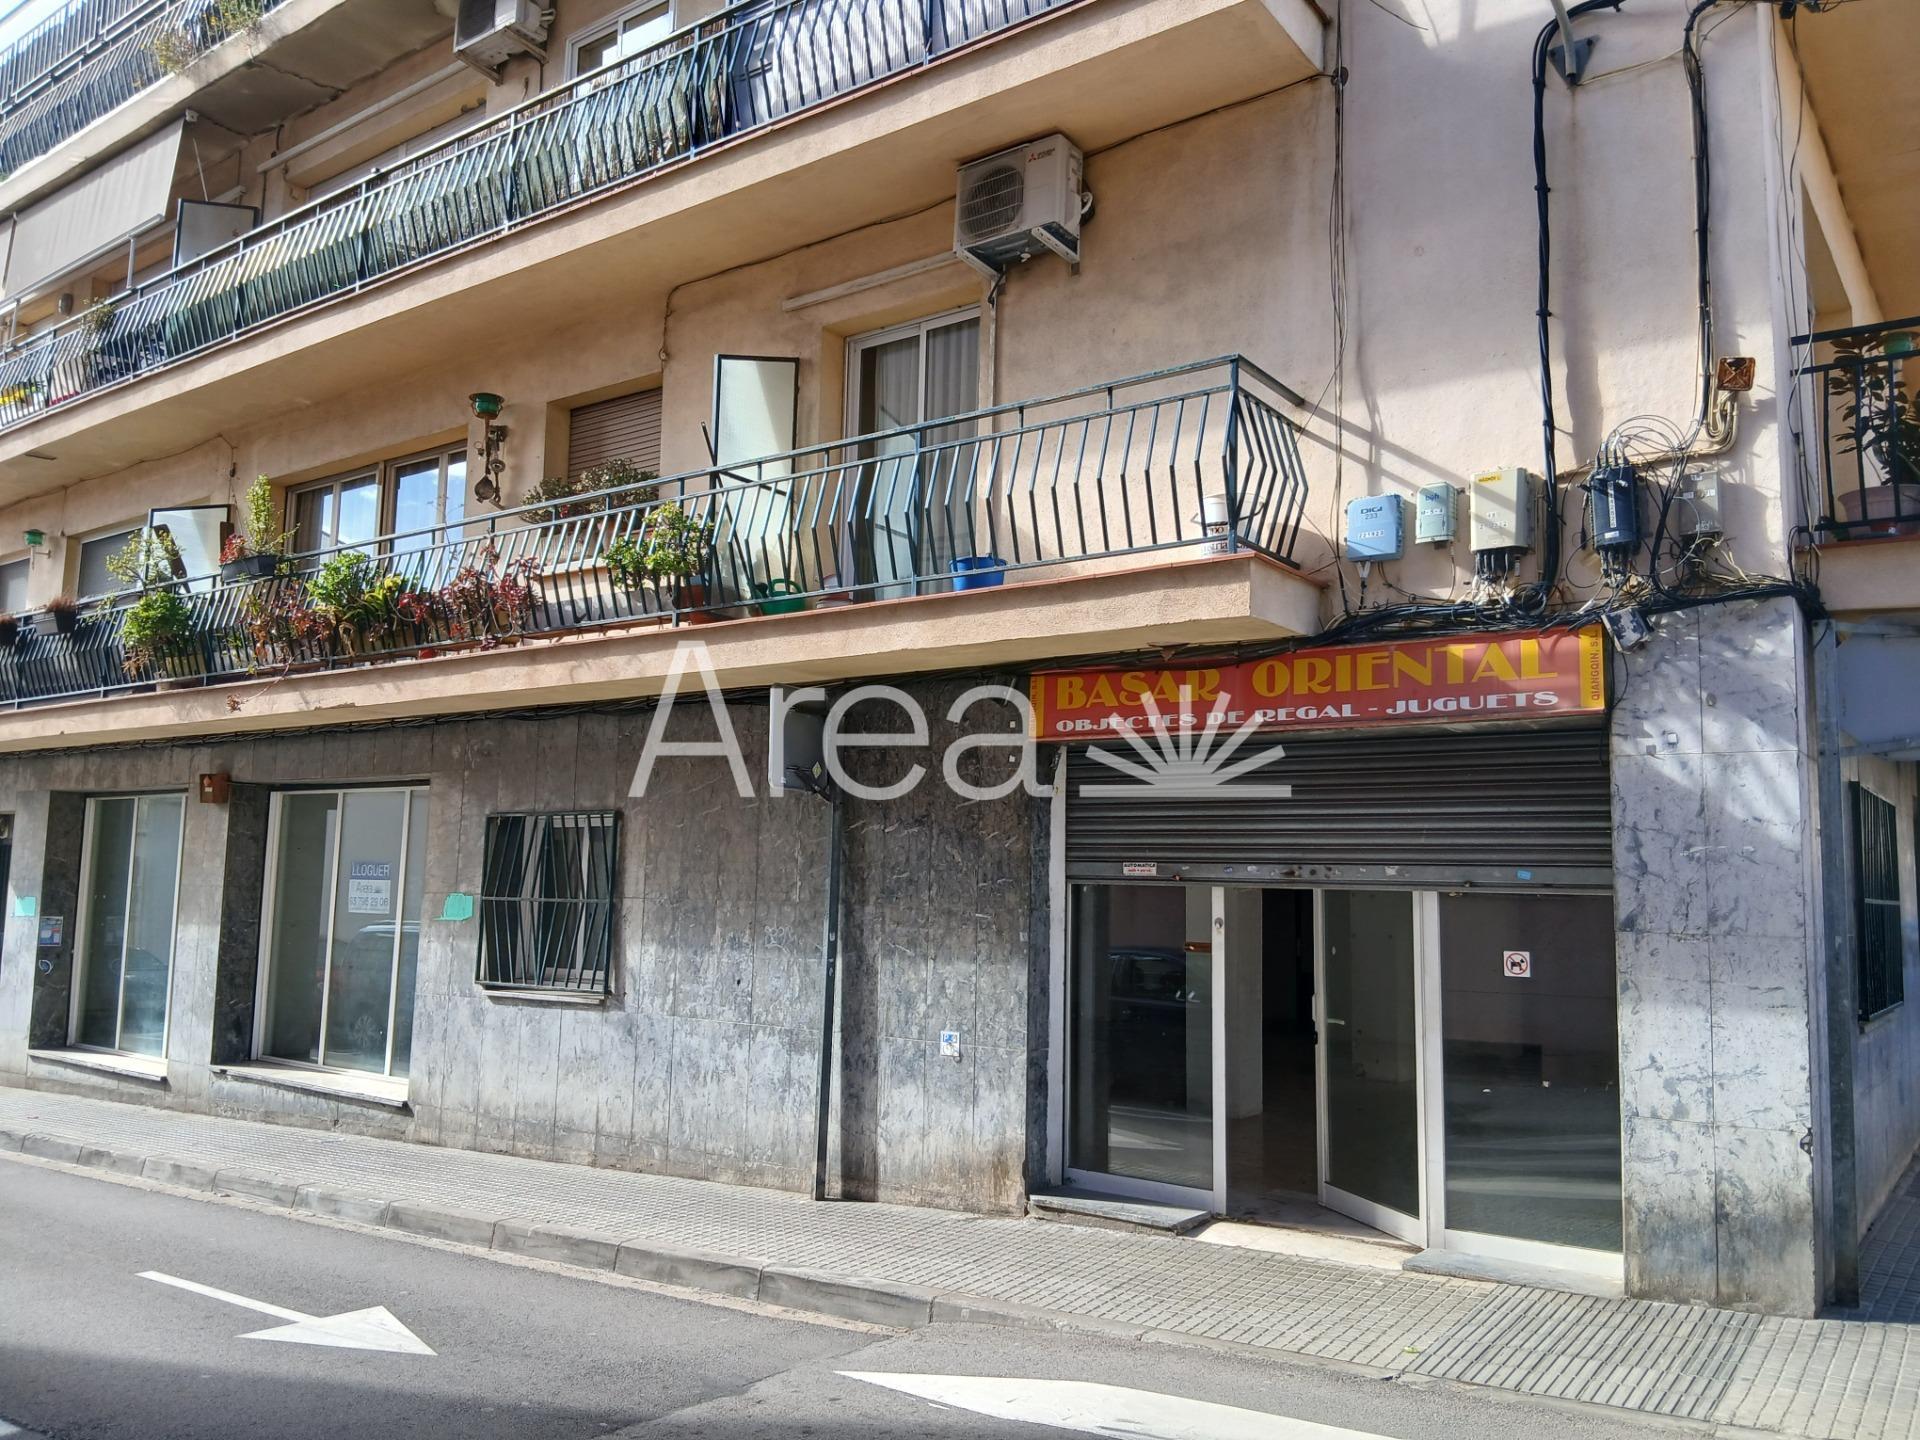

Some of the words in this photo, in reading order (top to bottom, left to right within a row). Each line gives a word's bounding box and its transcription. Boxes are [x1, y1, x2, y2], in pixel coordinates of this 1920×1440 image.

[1057, 668, 1221, 710] BASAR
[1252, 638, 1558, 697] ORIENTAL
[1056, 713, 1198, 732] OBJECTES
[1205, 710, 1245, 726] DE
[1255, 704, 1359, 722] REGAL
[1386, 691, 1559, 715] JUGUETS
[352, 864, 389, 876] LLOGUER
